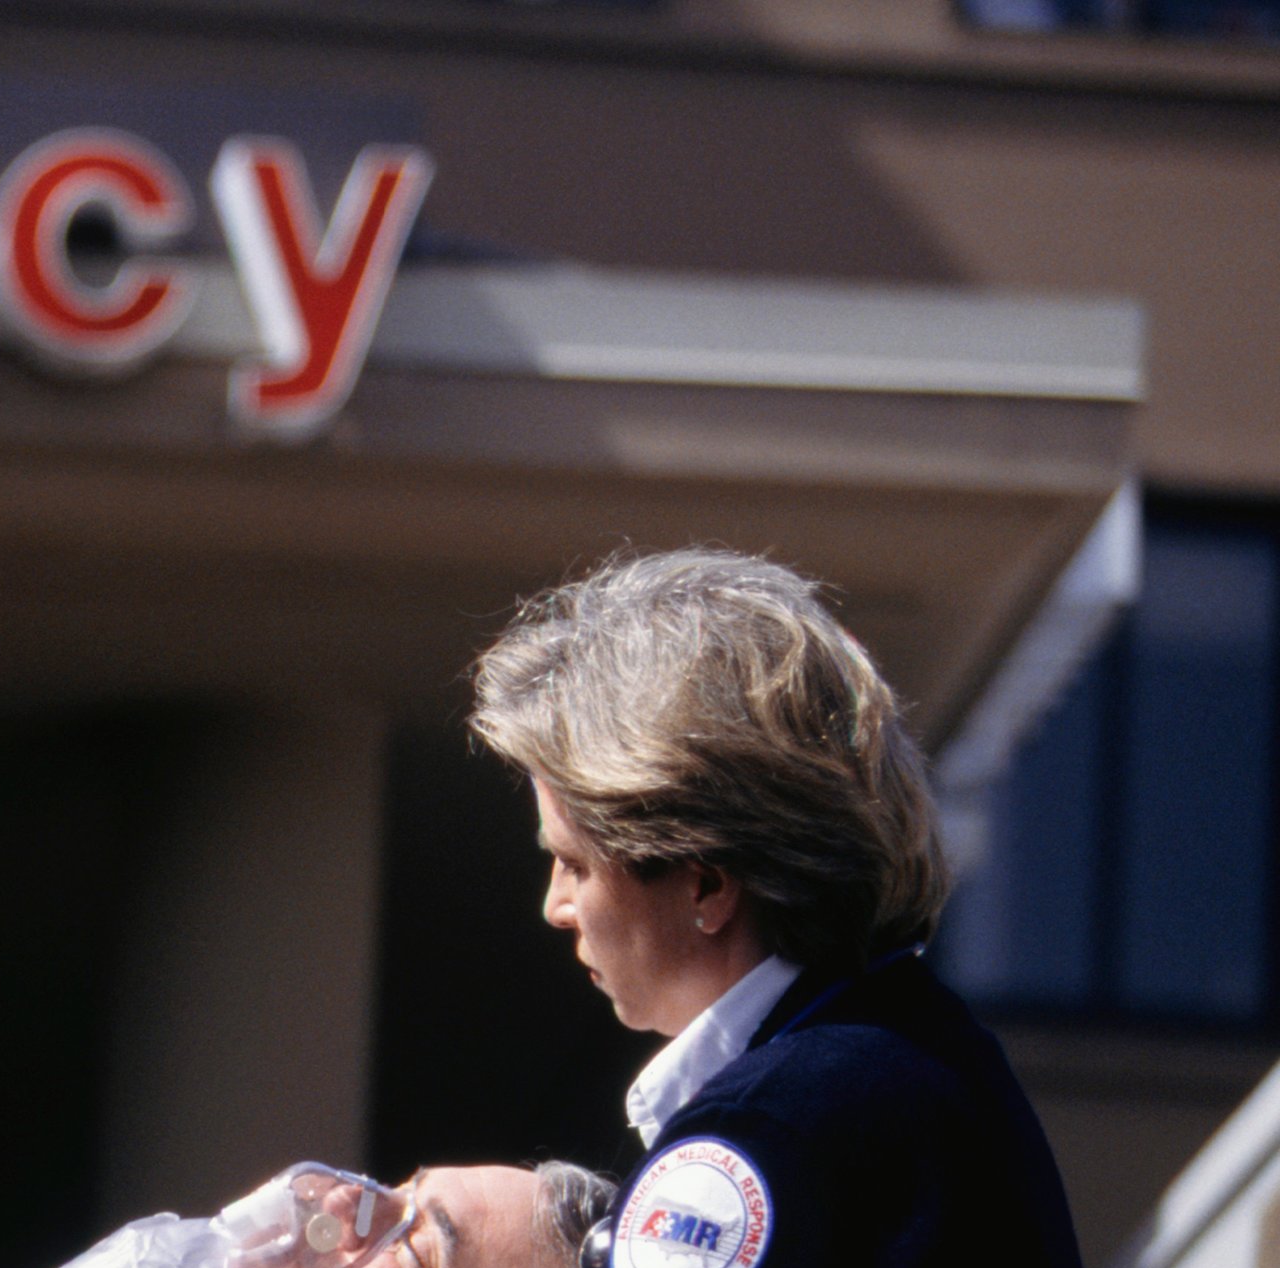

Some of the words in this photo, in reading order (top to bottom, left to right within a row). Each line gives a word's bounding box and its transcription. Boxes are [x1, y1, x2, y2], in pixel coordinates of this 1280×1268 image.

[618, 1162, 668, 1241] AMERICAN
[677, 1146, 740, 1177] MEDICAL
[735, 1177, 764, 1268] RESPONSE
[639, 1209, 722, 1252] AMR
